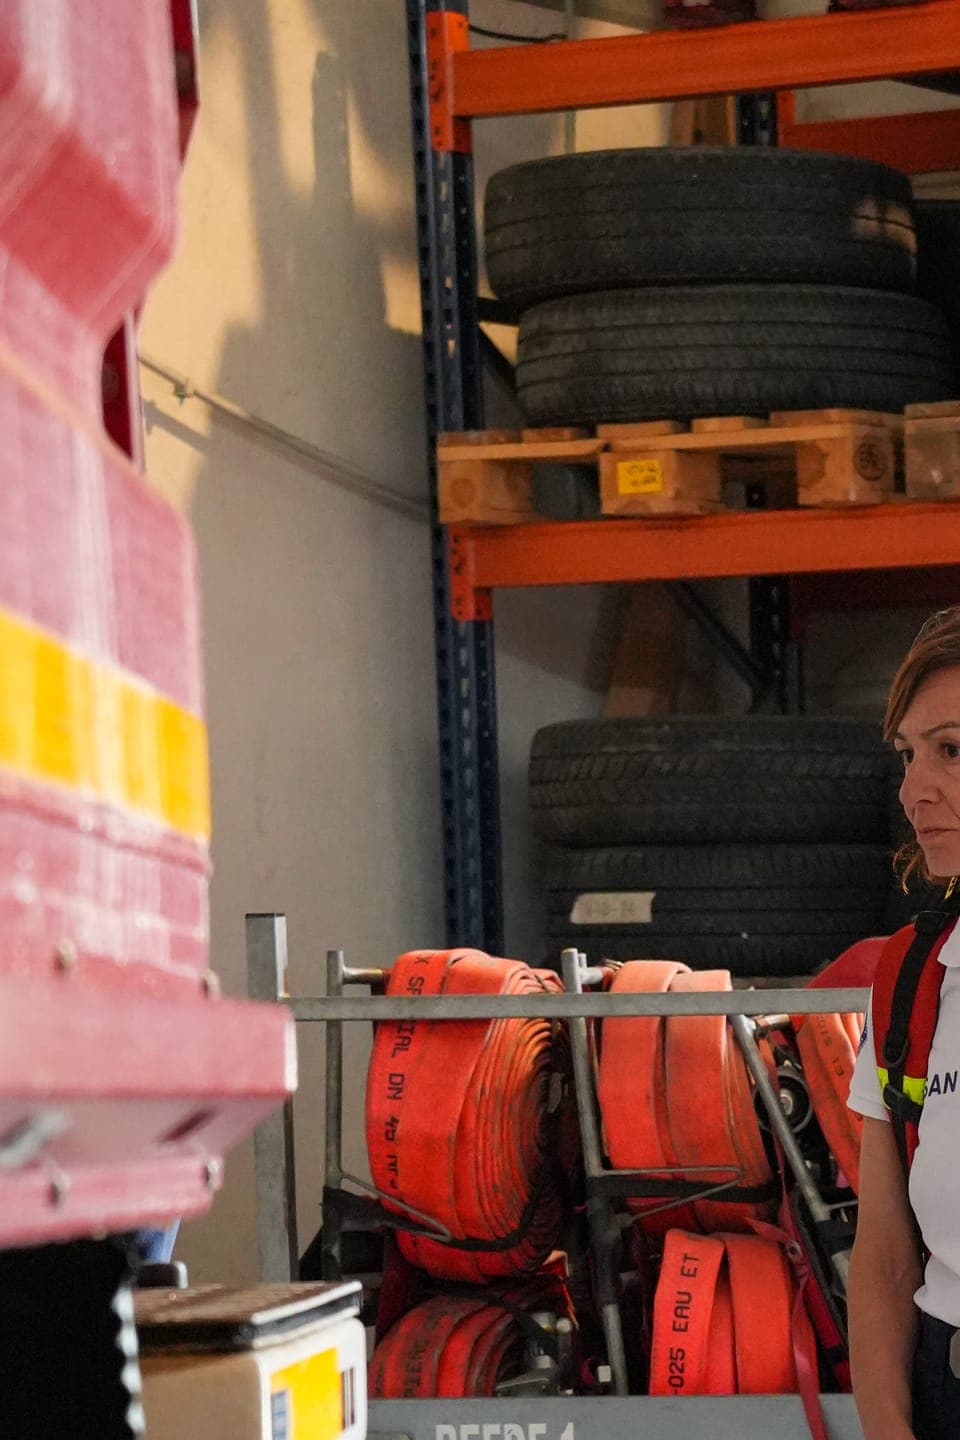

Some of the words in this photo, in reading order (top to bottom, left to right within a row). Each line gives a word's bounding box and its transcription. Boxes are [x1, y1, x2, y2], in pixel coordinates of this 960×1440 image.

[387, 1073, 405, 1101] DN
[926, 1070, 958, 1097] AN
[680, 1253, 699, 1278] ET
[672, 1291, 692, 1333] EAU
